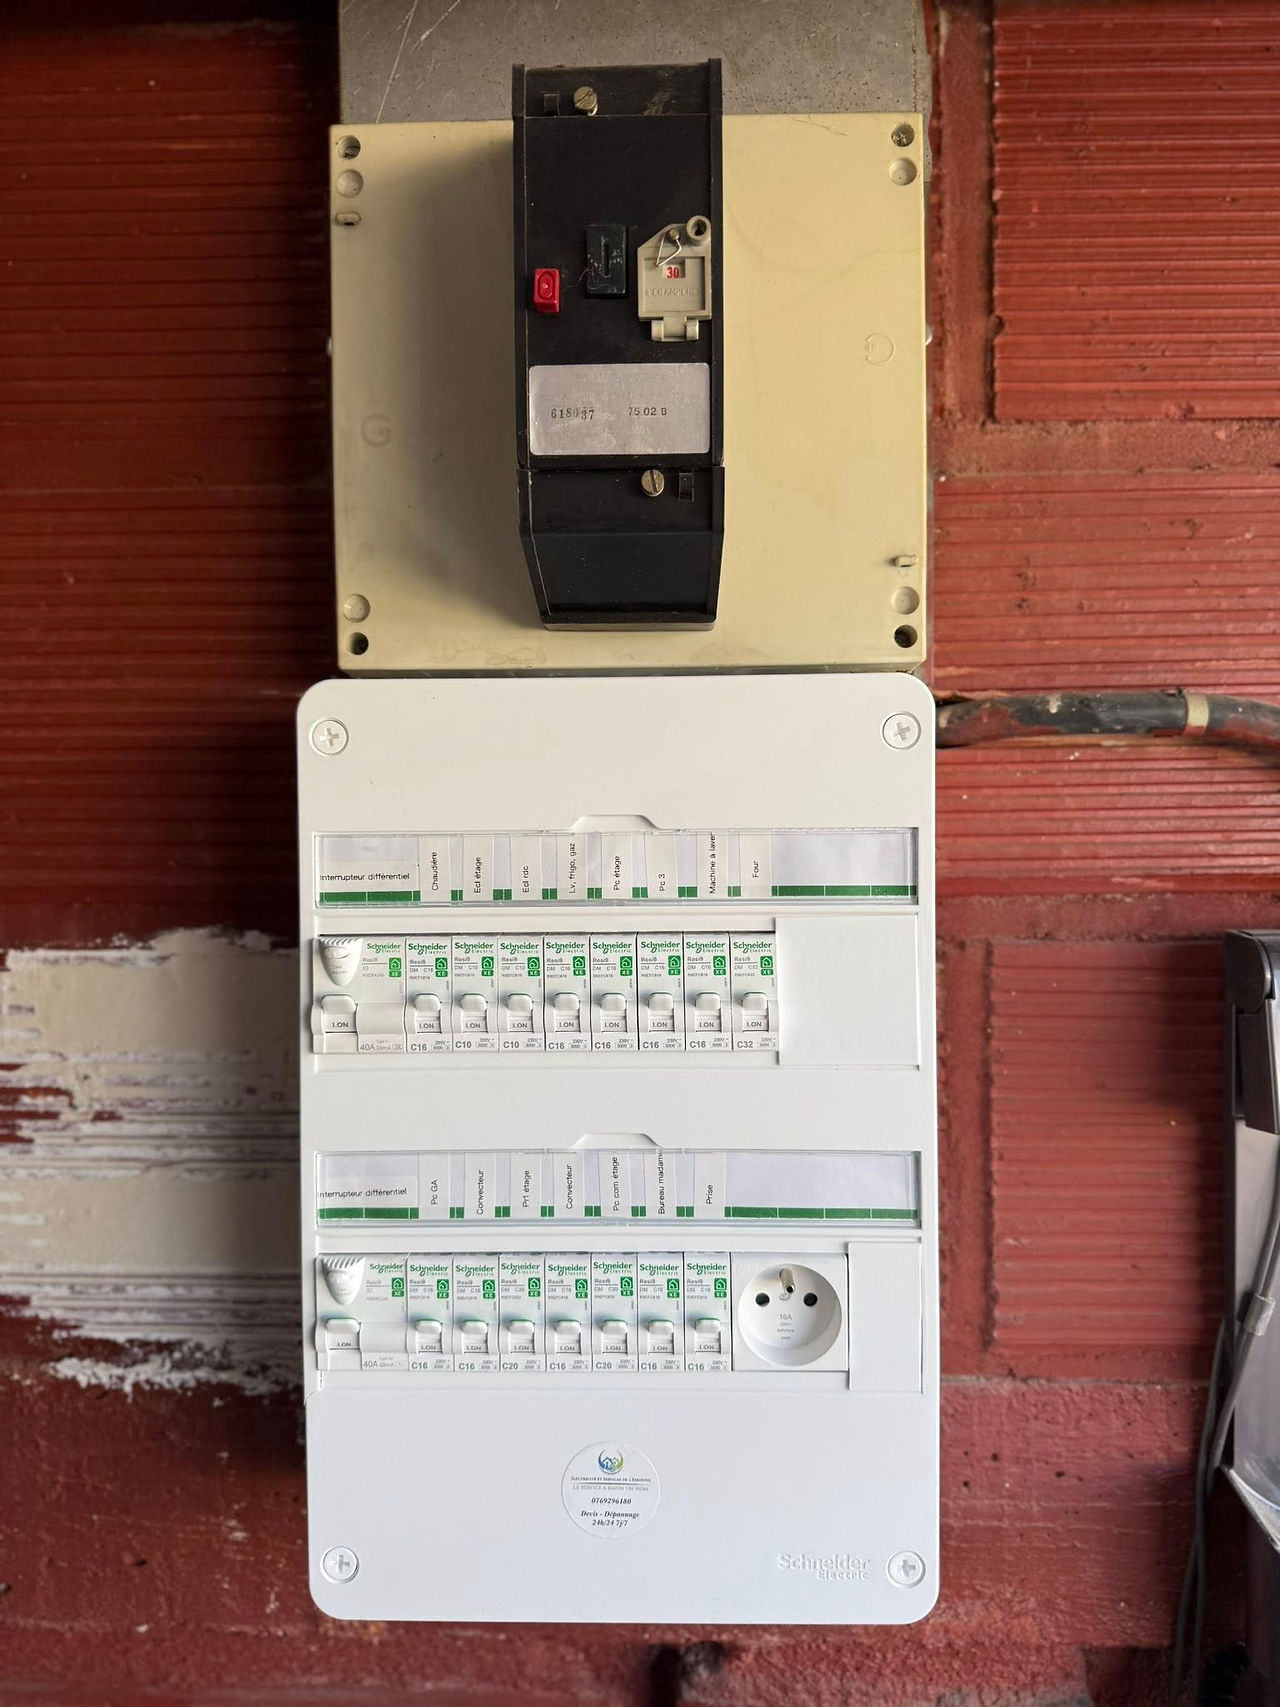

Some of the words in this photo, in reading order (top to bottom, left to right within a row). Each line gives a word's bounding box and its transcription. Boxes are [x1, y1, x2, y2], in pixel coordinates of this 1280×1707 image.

[667, 266, 679, 279] 30
[628, 407, 640, 416] 75
[643, 407, 657, 416] 02
[474, 857, 482, 879] étage
[613, 855, 621, 878] étage
[368, 872, 410, 880] différentiel
[613, 880, 620, 891] Pc
[659, 881, 666, 891] Pc
[367, 943, 401, 954] Schneider
[408, 943, 448, 955] Schneider
[454, 942, 494, 954] Schneider
[500, 943, 539, 954] Schneider
[546, 942, 585, 954] Schneider
[593, 942, 632, 954] Schneider
[641, 941, 680, 953] Schneider
[686, 942, 725, 953] Schneider
[733, 942, 772, 953] Schneider
[455, 1041, 472, 1049] C10
[503, 1041, 520, 1049] C10
[548, 1042, 565, 1050] C16
[595, 1041, 611, 1049] C16
[643, 1041, 659, 1049] C16
[430, 1180, 438, 1192] GA
[320, 1190, 362, 1198] nterrupteur
[365, 1188, 407, 1196] différentiel
[476, 1170, 484, 1215] Convecteur
[430, 1194, 437, 1205] Pc
[657, 1186, 665, 1214] Bureau
[613, 1201, 620, 1211] Pc
[370, 1263, 404, 1274] Schneider
[410, 1265, 448, 1276] Schneider
[456, 1264, 496, 1277] Schneider
[501, 1263, 540, 1275] Schneider
[548, 1264, 587, 1276] Schneider
[593, 1261, 632, 1274] Schneider
[640, 1264, 679, 1276] Schneider
[687, 1263, 727, 1275] Schneider
[364, 1360, 378, 1368] 40A
[459, 1362, 475, 1370] C16
[502, 1362, 518, 1370] C20
[550, 1362, 566, 1370] C16
[641, 1362, 657, 1370] C16
[688, 1363, 704, 1371] C16
